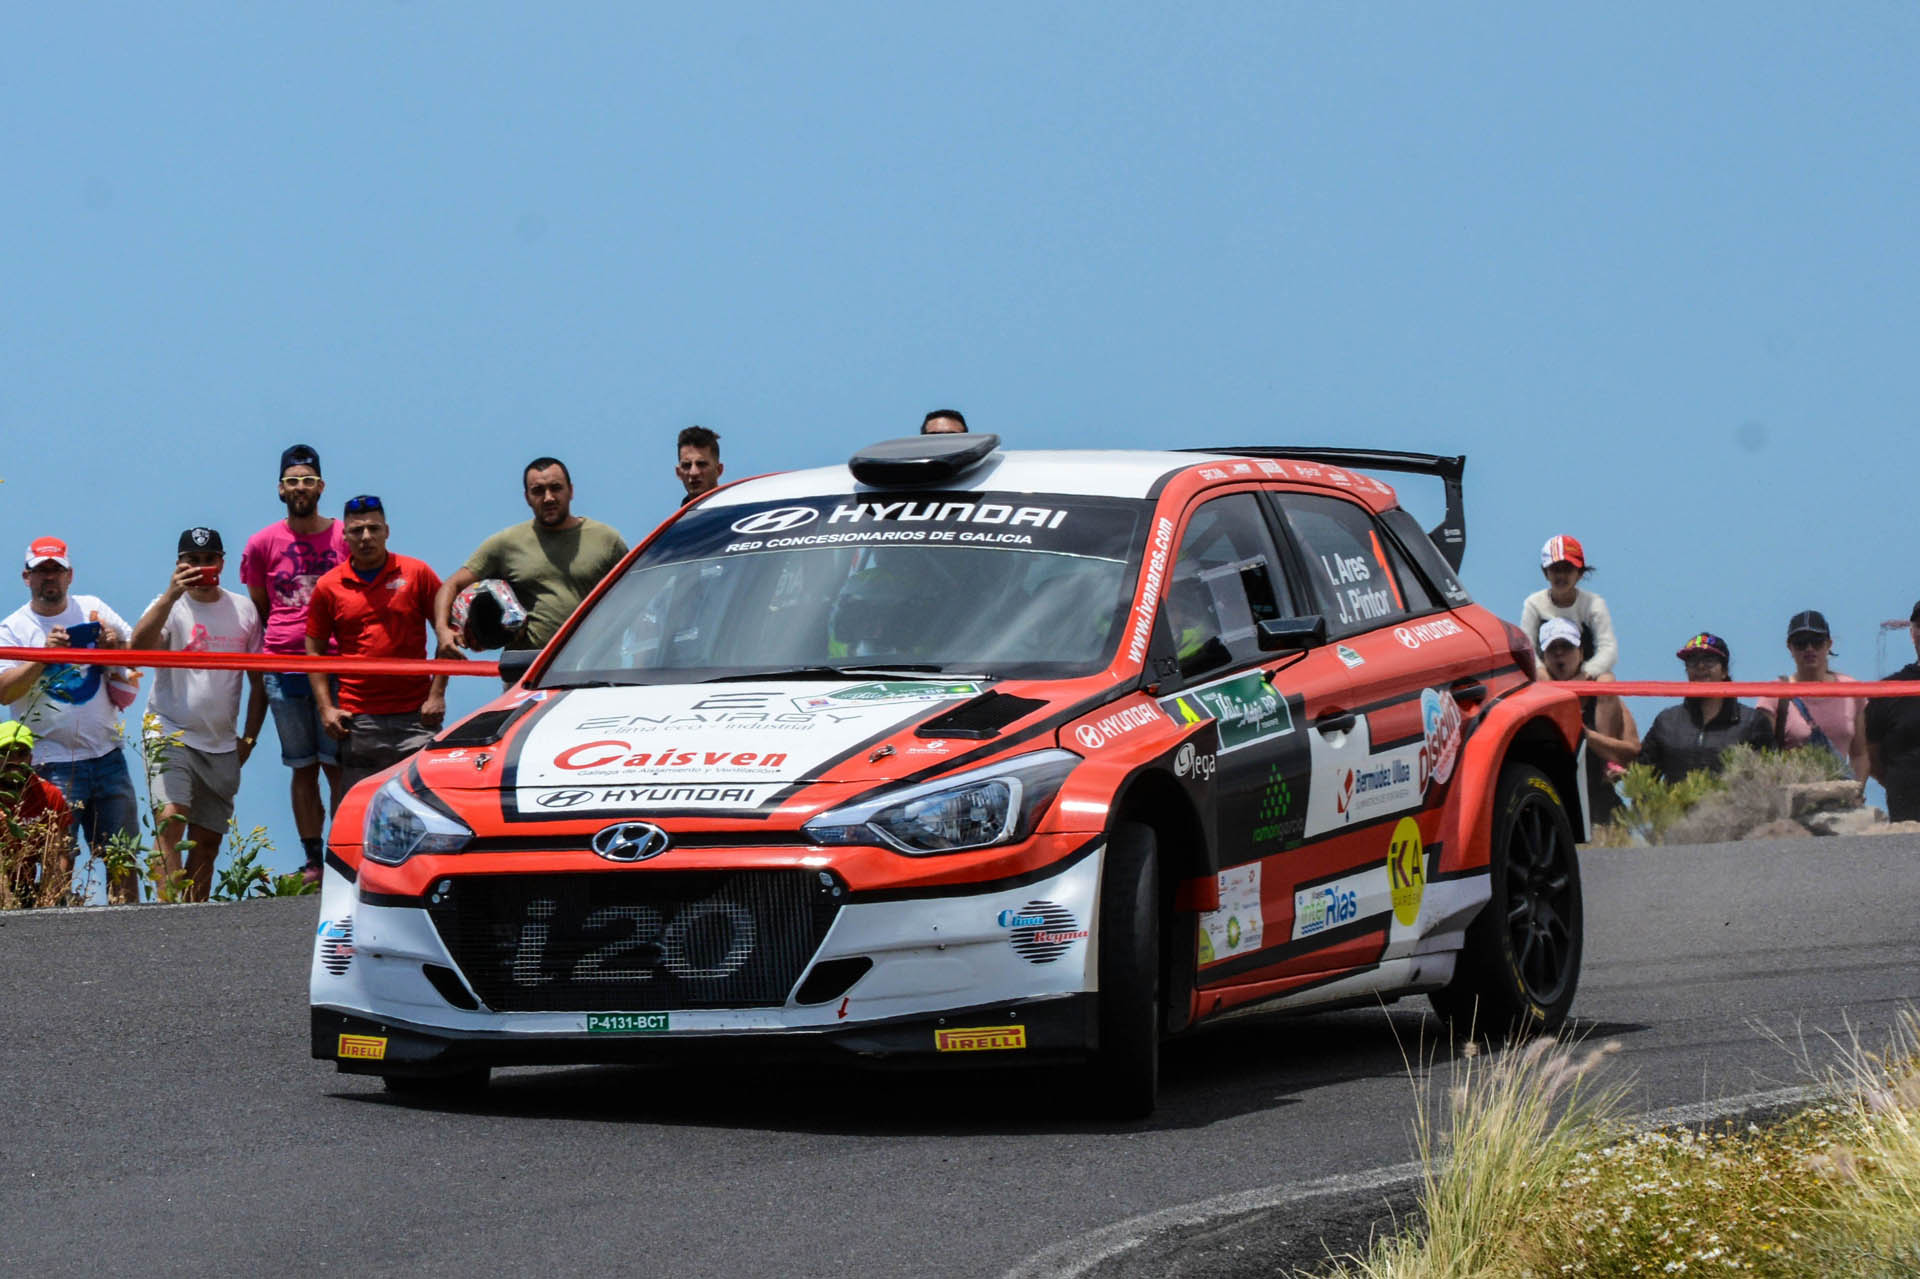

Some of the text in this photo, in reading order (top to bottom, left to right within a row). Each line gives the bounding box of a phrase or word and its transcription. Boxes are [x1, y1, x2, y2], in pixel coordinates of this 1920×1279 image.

[828, 502, 1068, 529] HYUNDAI
[725, 531, 1032, 552] RED CONCESIONARIOS DE GALICIA
[1333, 552, 1371, 584] Ares
[1128, 517, 1173, 664] www.ivanares.com
[1336, 587, 1391, 624] J. Pintor
[1096, 702, 1161, 738] HYUNDAI
[601, 788, 755, 803] HYUNDAI
[998, 910, 1045, 928] Clima
[513, 900, 757, 987] i20
[1033, 931, 1089, 944] Reyma
[589, 1015, 667, 1030] P-4131-BCT
[340, 1036, 384, 1057] PIRELLI
[939, 1028, 1021, 1049] PIRELLI
